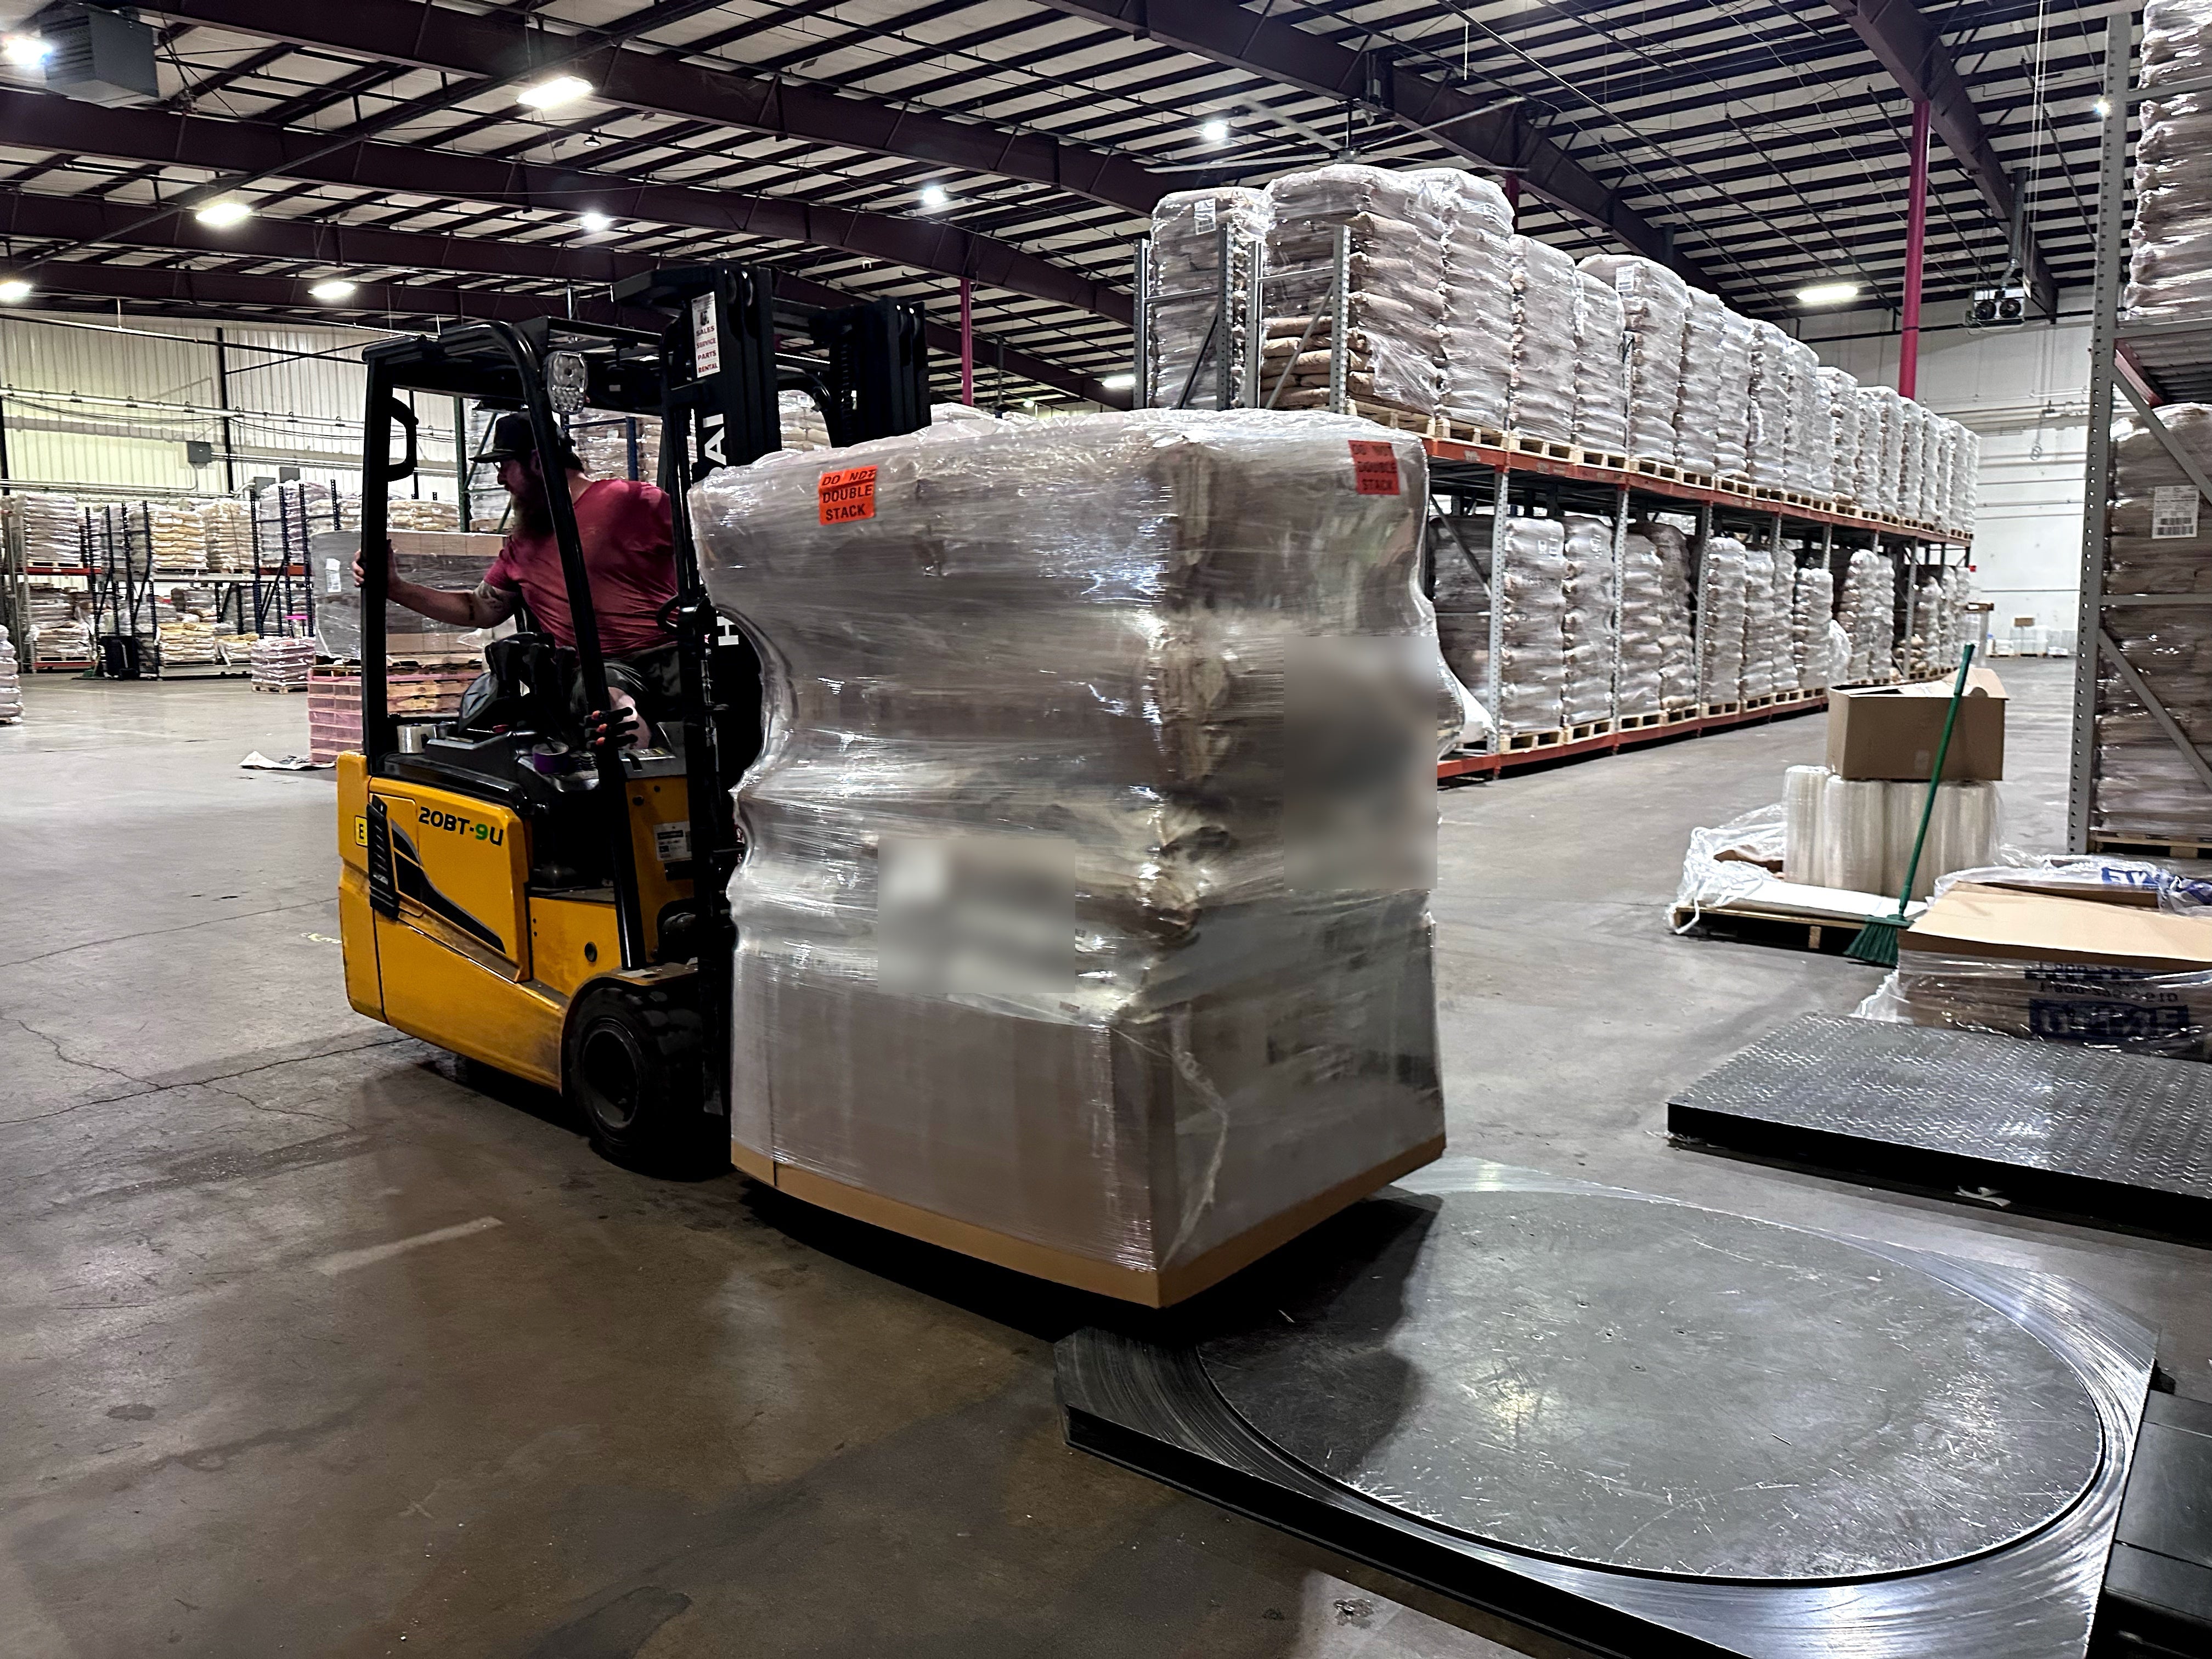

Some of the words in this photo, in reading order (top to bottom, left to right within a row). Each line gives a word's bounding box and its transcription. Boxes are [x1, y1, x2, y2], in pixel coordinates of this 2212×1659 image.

[696, 325, 715, 336] SALES
[696, 337, 716, 349] SERVICE
[697, 350, 717, 360] PARTS
[698, 362, 718, 373] RENTAL
[822, 476, 840, 485] DO
[850, 469, 876, 481] NOT
[823, 485, 872, 503] DOUBLE
[826, 504, 866, 521] STACK
[419, 806, 504, 847] 20BT-9U
